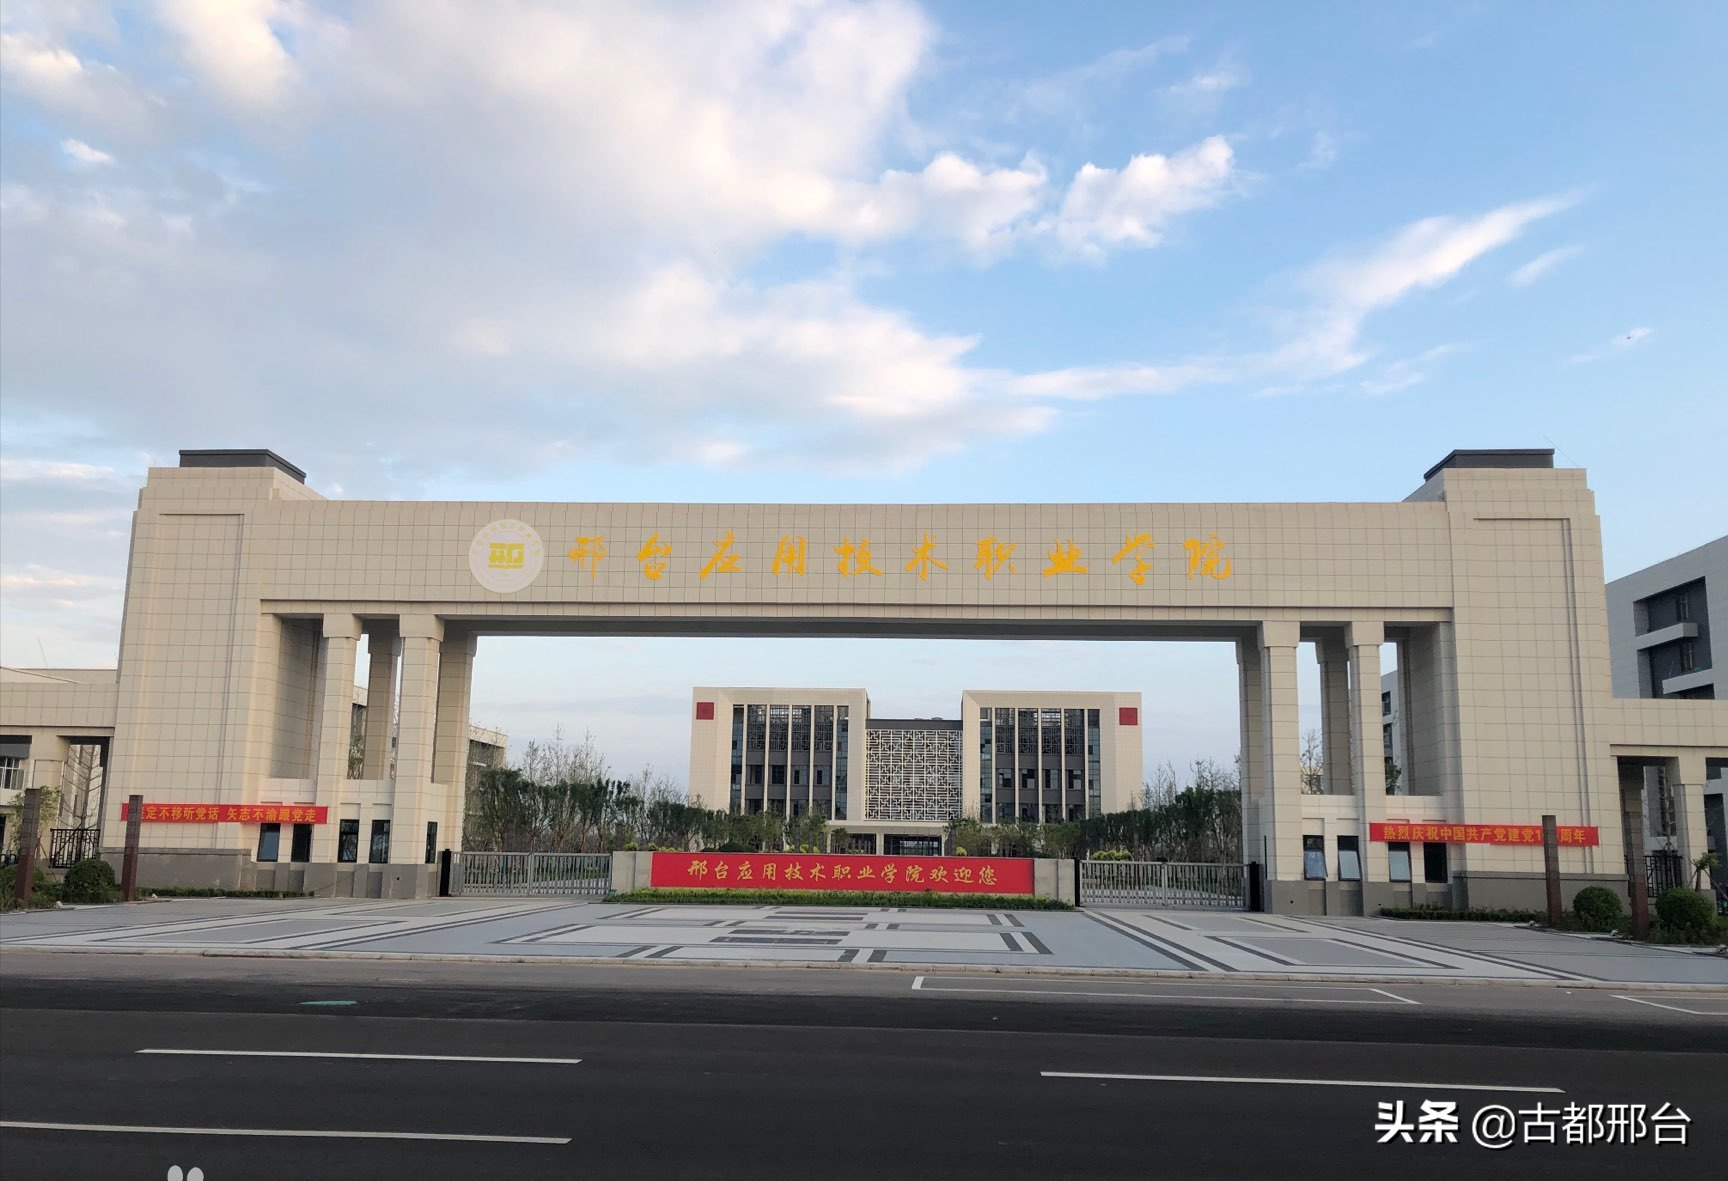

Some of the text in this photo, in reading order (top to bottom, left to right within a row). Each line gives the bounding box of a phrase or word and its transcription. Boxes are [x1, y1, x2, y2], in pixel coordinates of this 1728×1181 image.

[567, 530, 1232, 586] 邢台应用技术职业学院
[141, 806, 317, 822] 定不移听党话 矢志不渝跟党走
[1383, 825, 1586, 843] 热烈庆祝中国共产党建党1周年
[687, 860, 998, 886] 邢台应用技术职业学院欢迎您
